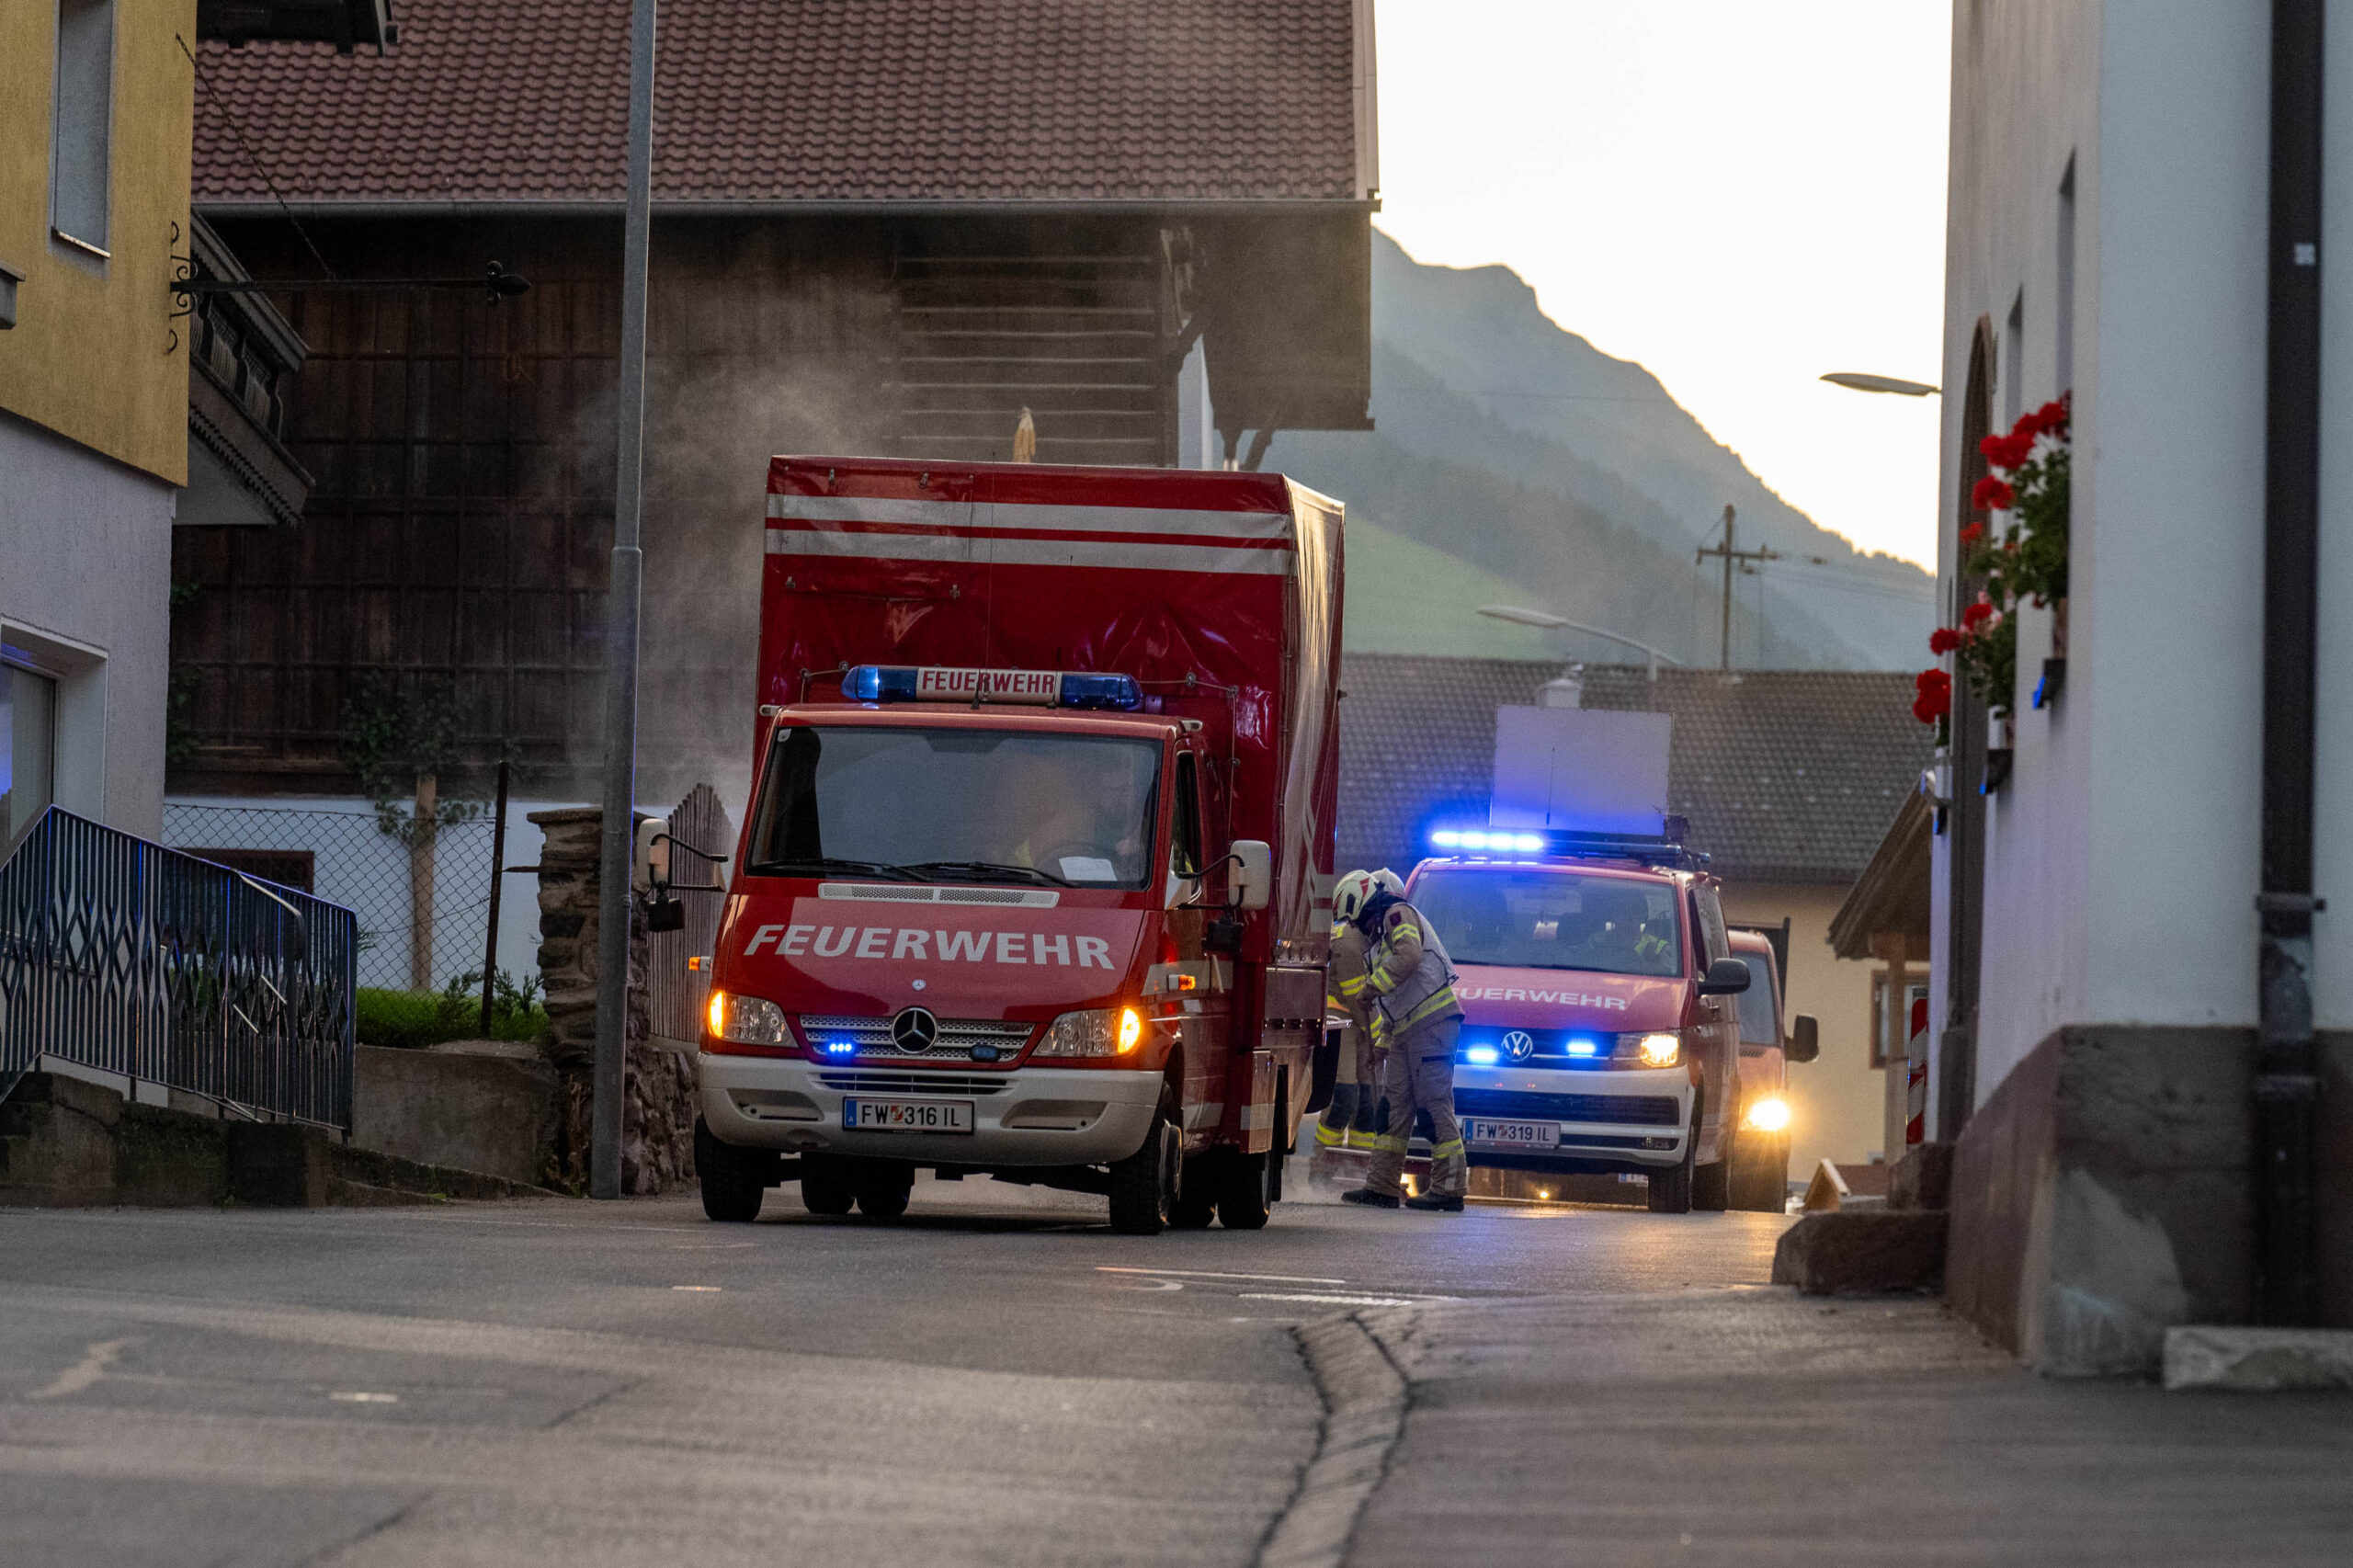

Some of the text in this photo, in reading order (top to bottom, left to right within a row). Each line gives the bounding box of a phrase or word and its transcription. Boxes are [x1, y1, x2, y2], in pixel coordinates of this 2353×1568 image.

[922, 670, 1055, 694] FEUERWEHR
[744, 925, 1115, 971] FEUERWEHR
[861, 1105, 961, 1127] FW 316 IL
[1476, 1123, 1550, 1142] FW 319 IL
